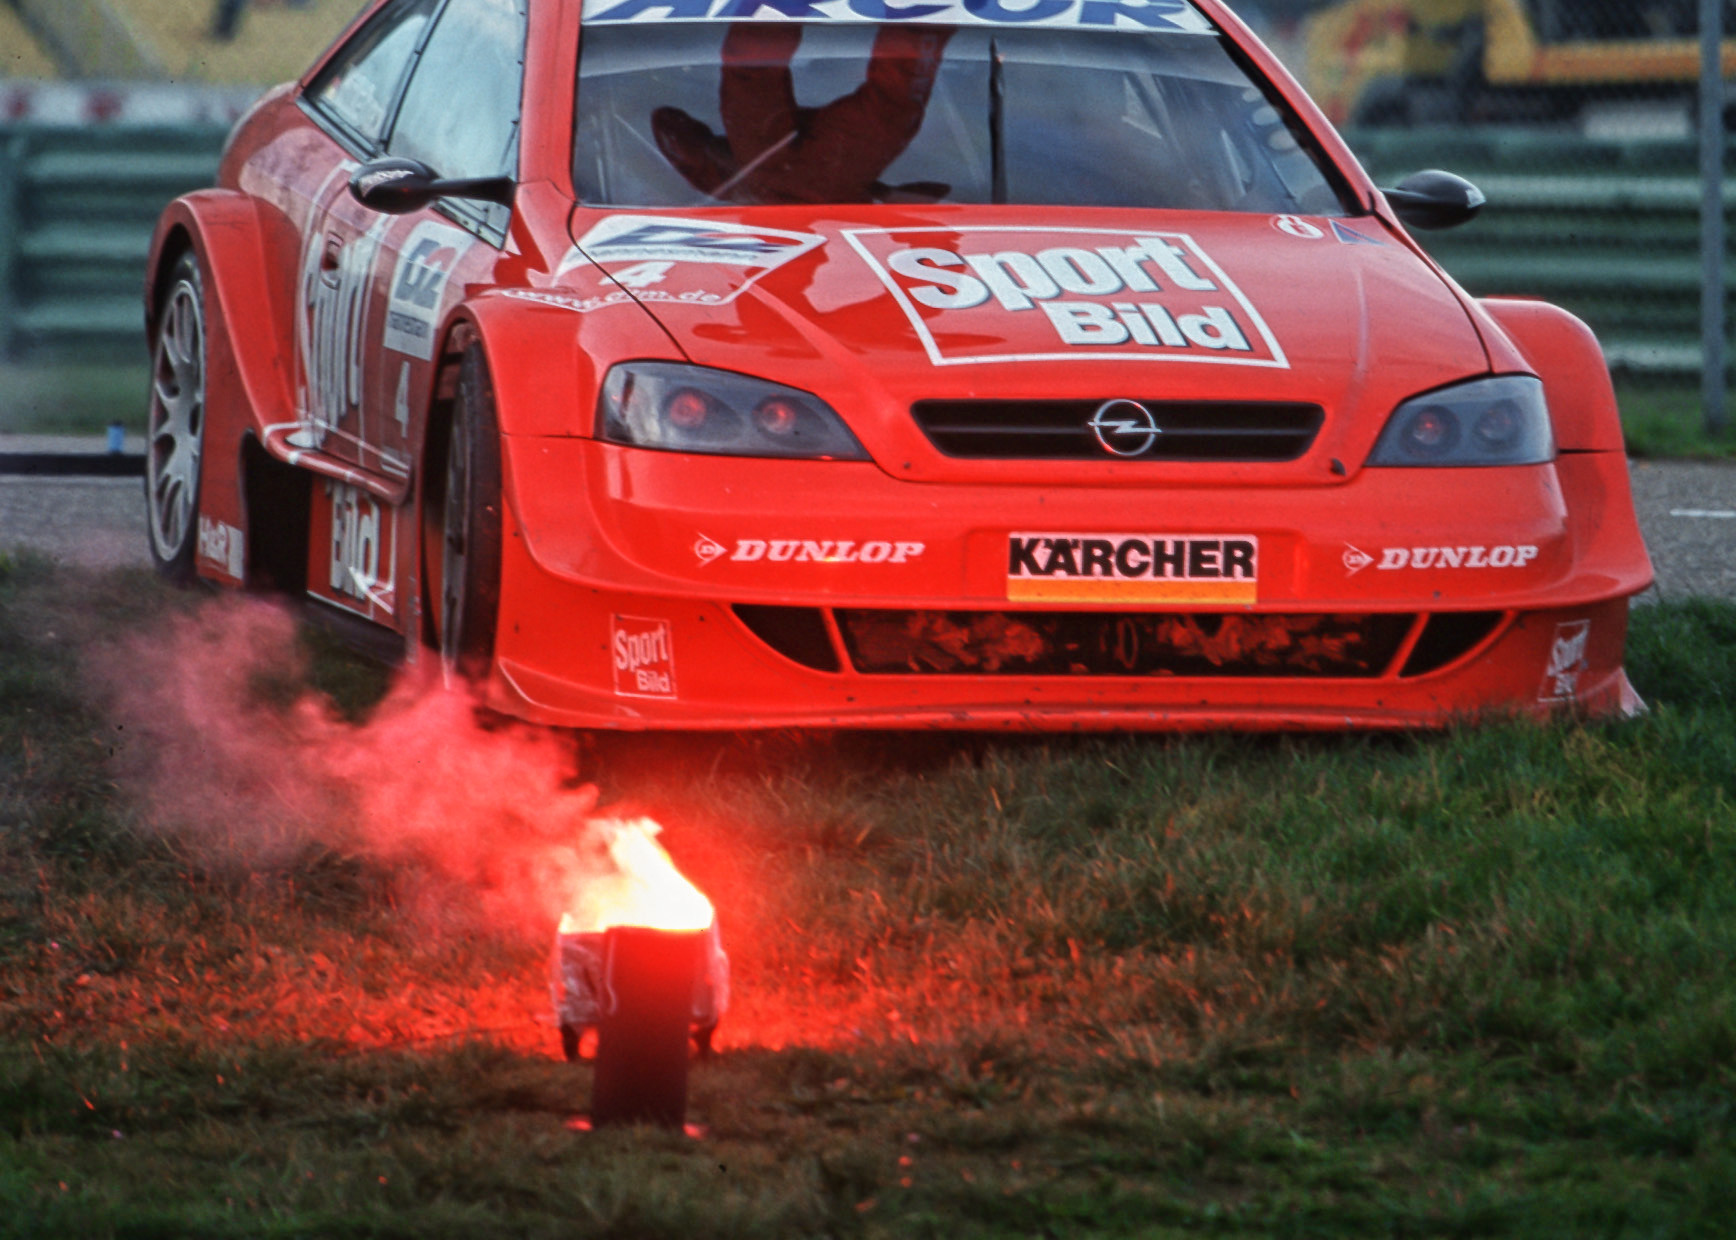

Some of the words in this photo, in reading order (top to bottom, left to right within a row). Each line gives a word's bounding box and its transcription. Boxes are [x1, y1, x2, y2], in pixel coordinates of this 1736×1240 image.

[598, 261, 676, 288] 4
[887, 237, 1218, 311] Sport
[1040, 302, 1252, 351] Bild
[731, 540, 926, 563] DUNLOP
[1008, 537, 1256, 579] KÄRCHER
[1376, 544, 1538, 570] DUNLOP
[615, 623, 669, 673] Sport
[636, 668, 671, 694] Bild
